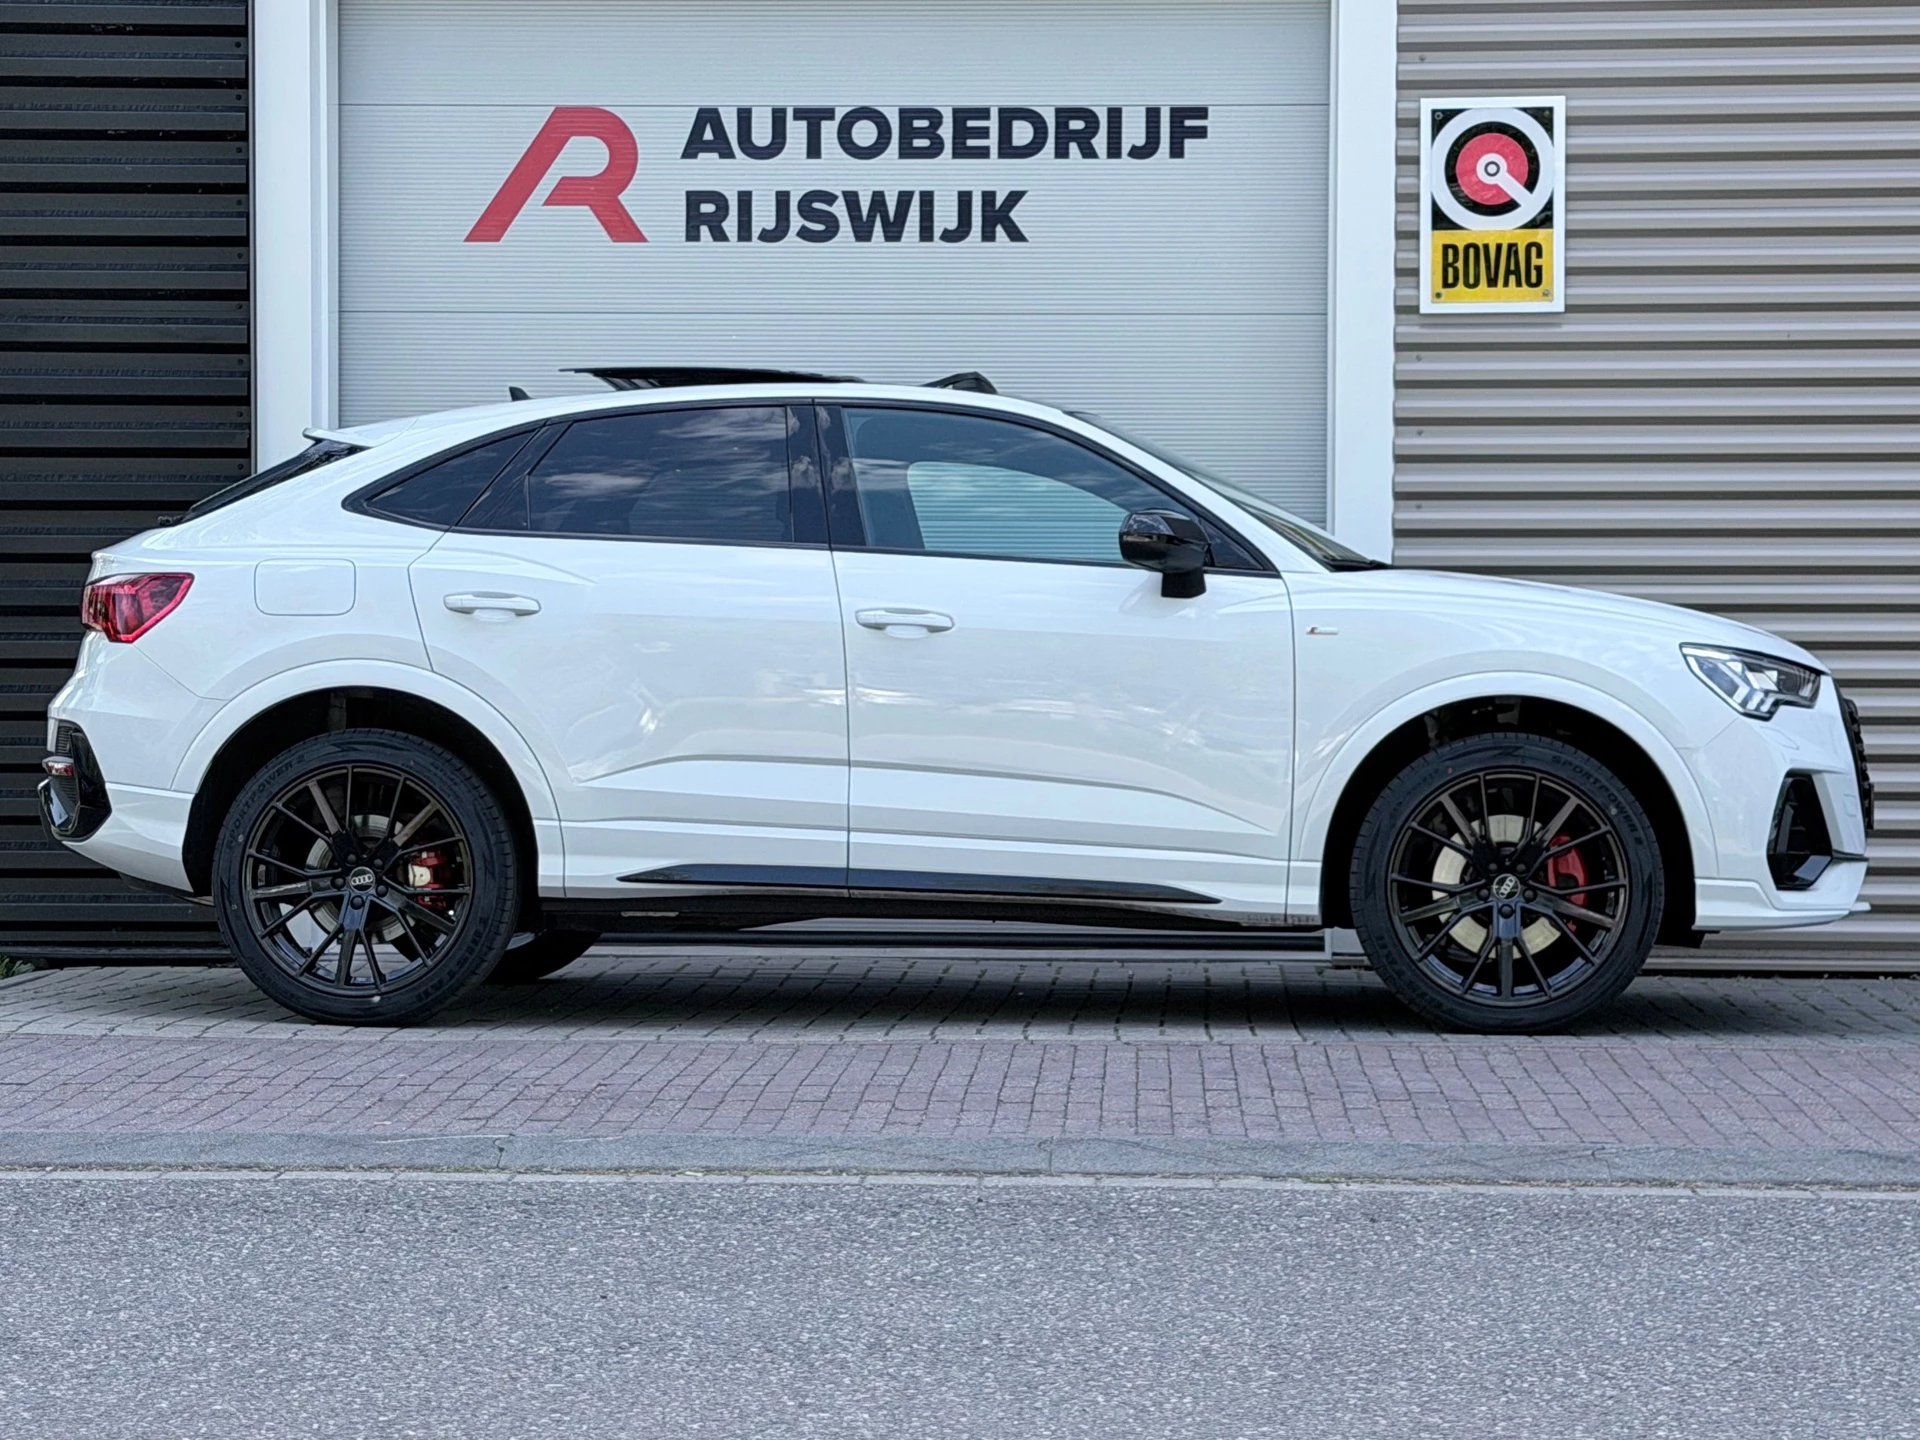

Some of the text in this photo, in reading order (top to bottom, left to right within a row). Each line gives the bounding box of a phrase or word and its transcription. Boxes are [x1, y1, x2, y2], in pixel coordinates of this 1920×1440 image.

[680, 106, 1209, 160] AUTOBEDRIJF
[685, 190, 1029, 243] RIJSWIJK
[1441, 241, 1543, 289] BOVAG
